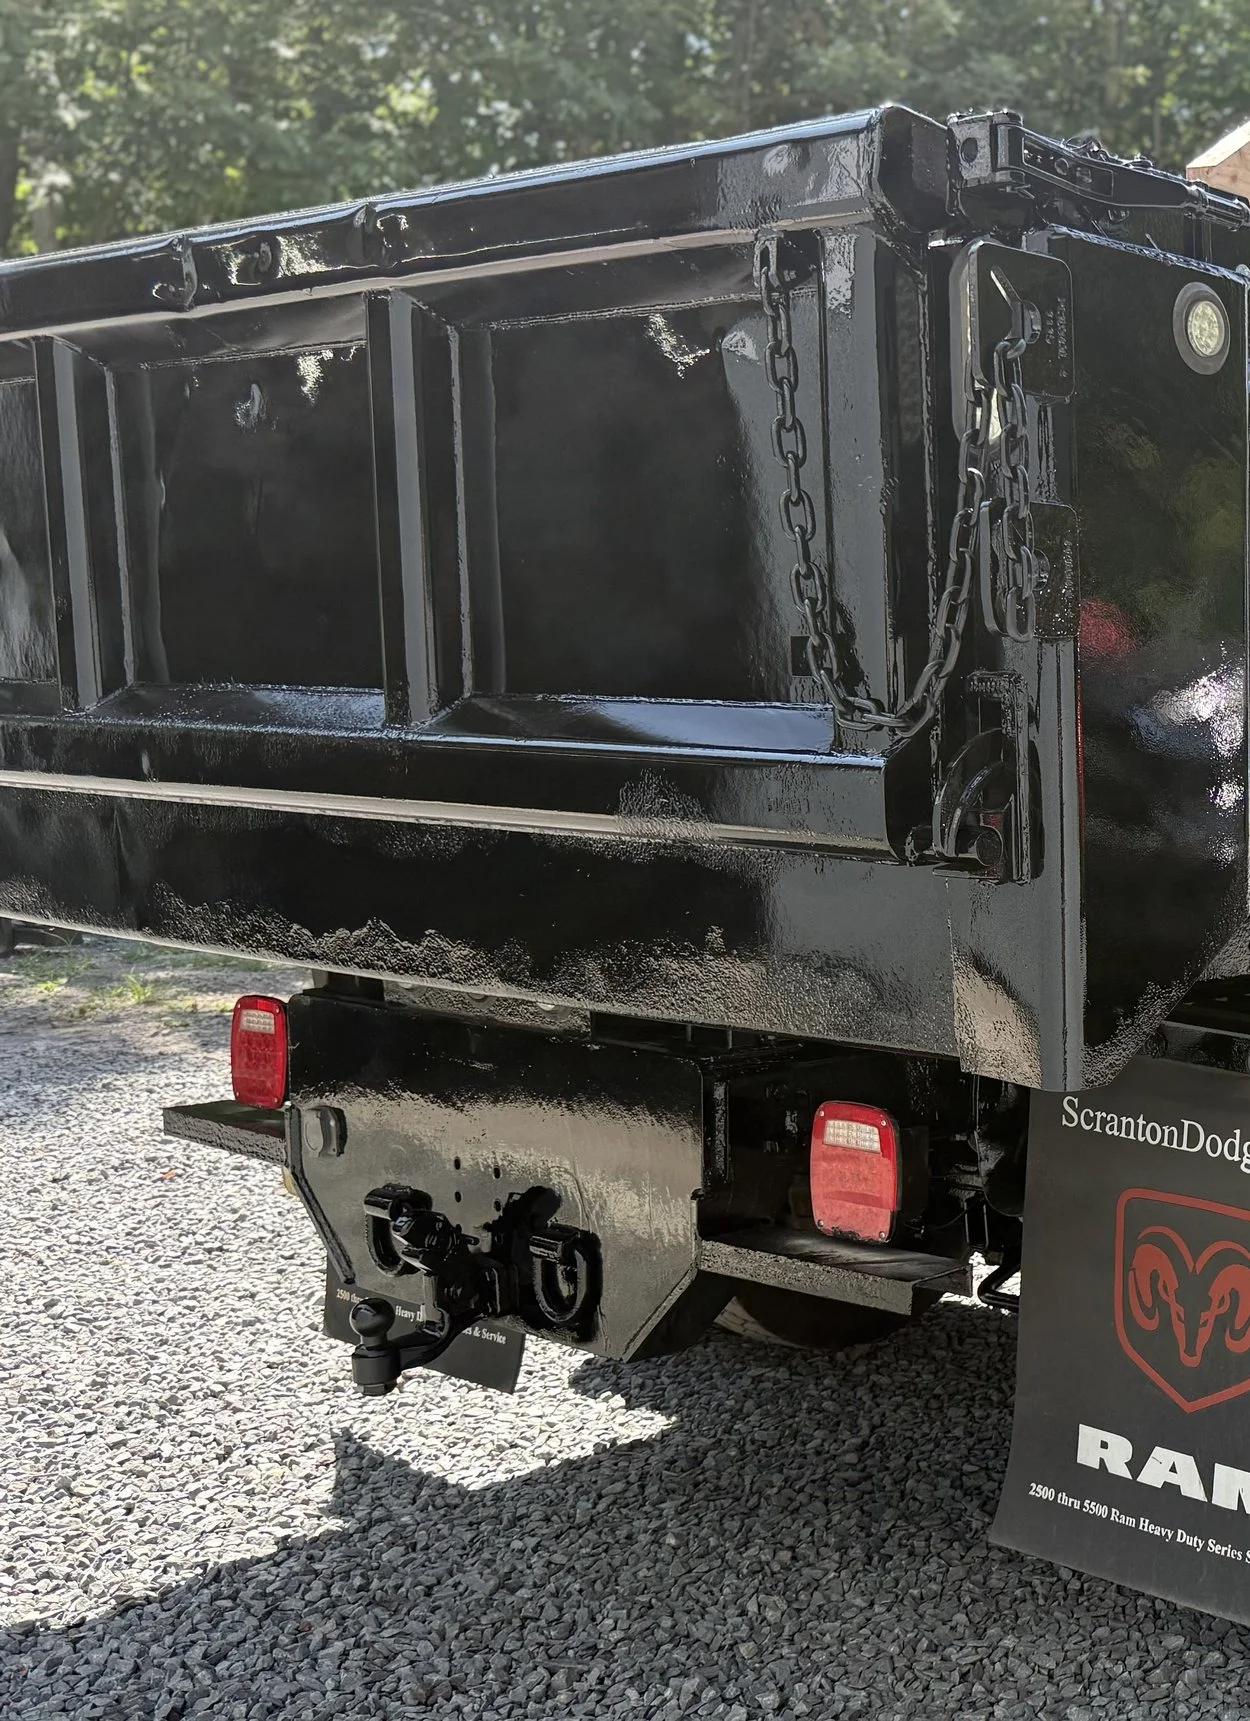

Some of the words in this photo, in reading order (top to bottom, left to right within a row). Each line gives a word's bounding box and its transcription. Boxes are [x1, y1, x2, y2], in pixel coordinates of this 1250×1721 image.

[395, 1306, 416, 1322] Heavy
[473, 1326, 481, 1337] &
[482, 1328, 507, 1345] Service
[1028, 1482, 1056, 1502] 2500
[1057, 1492, 1081, 1511] thru
[1082, 1499, 1109, 1519] 5500
[1109, 1508, 1136, 1529] Ram
[1138, 1517, 1175, 1543] Heavy
[1176, 1529, 1206, 1553] Duty
[1207, 1538, 1243, 1562] Series
